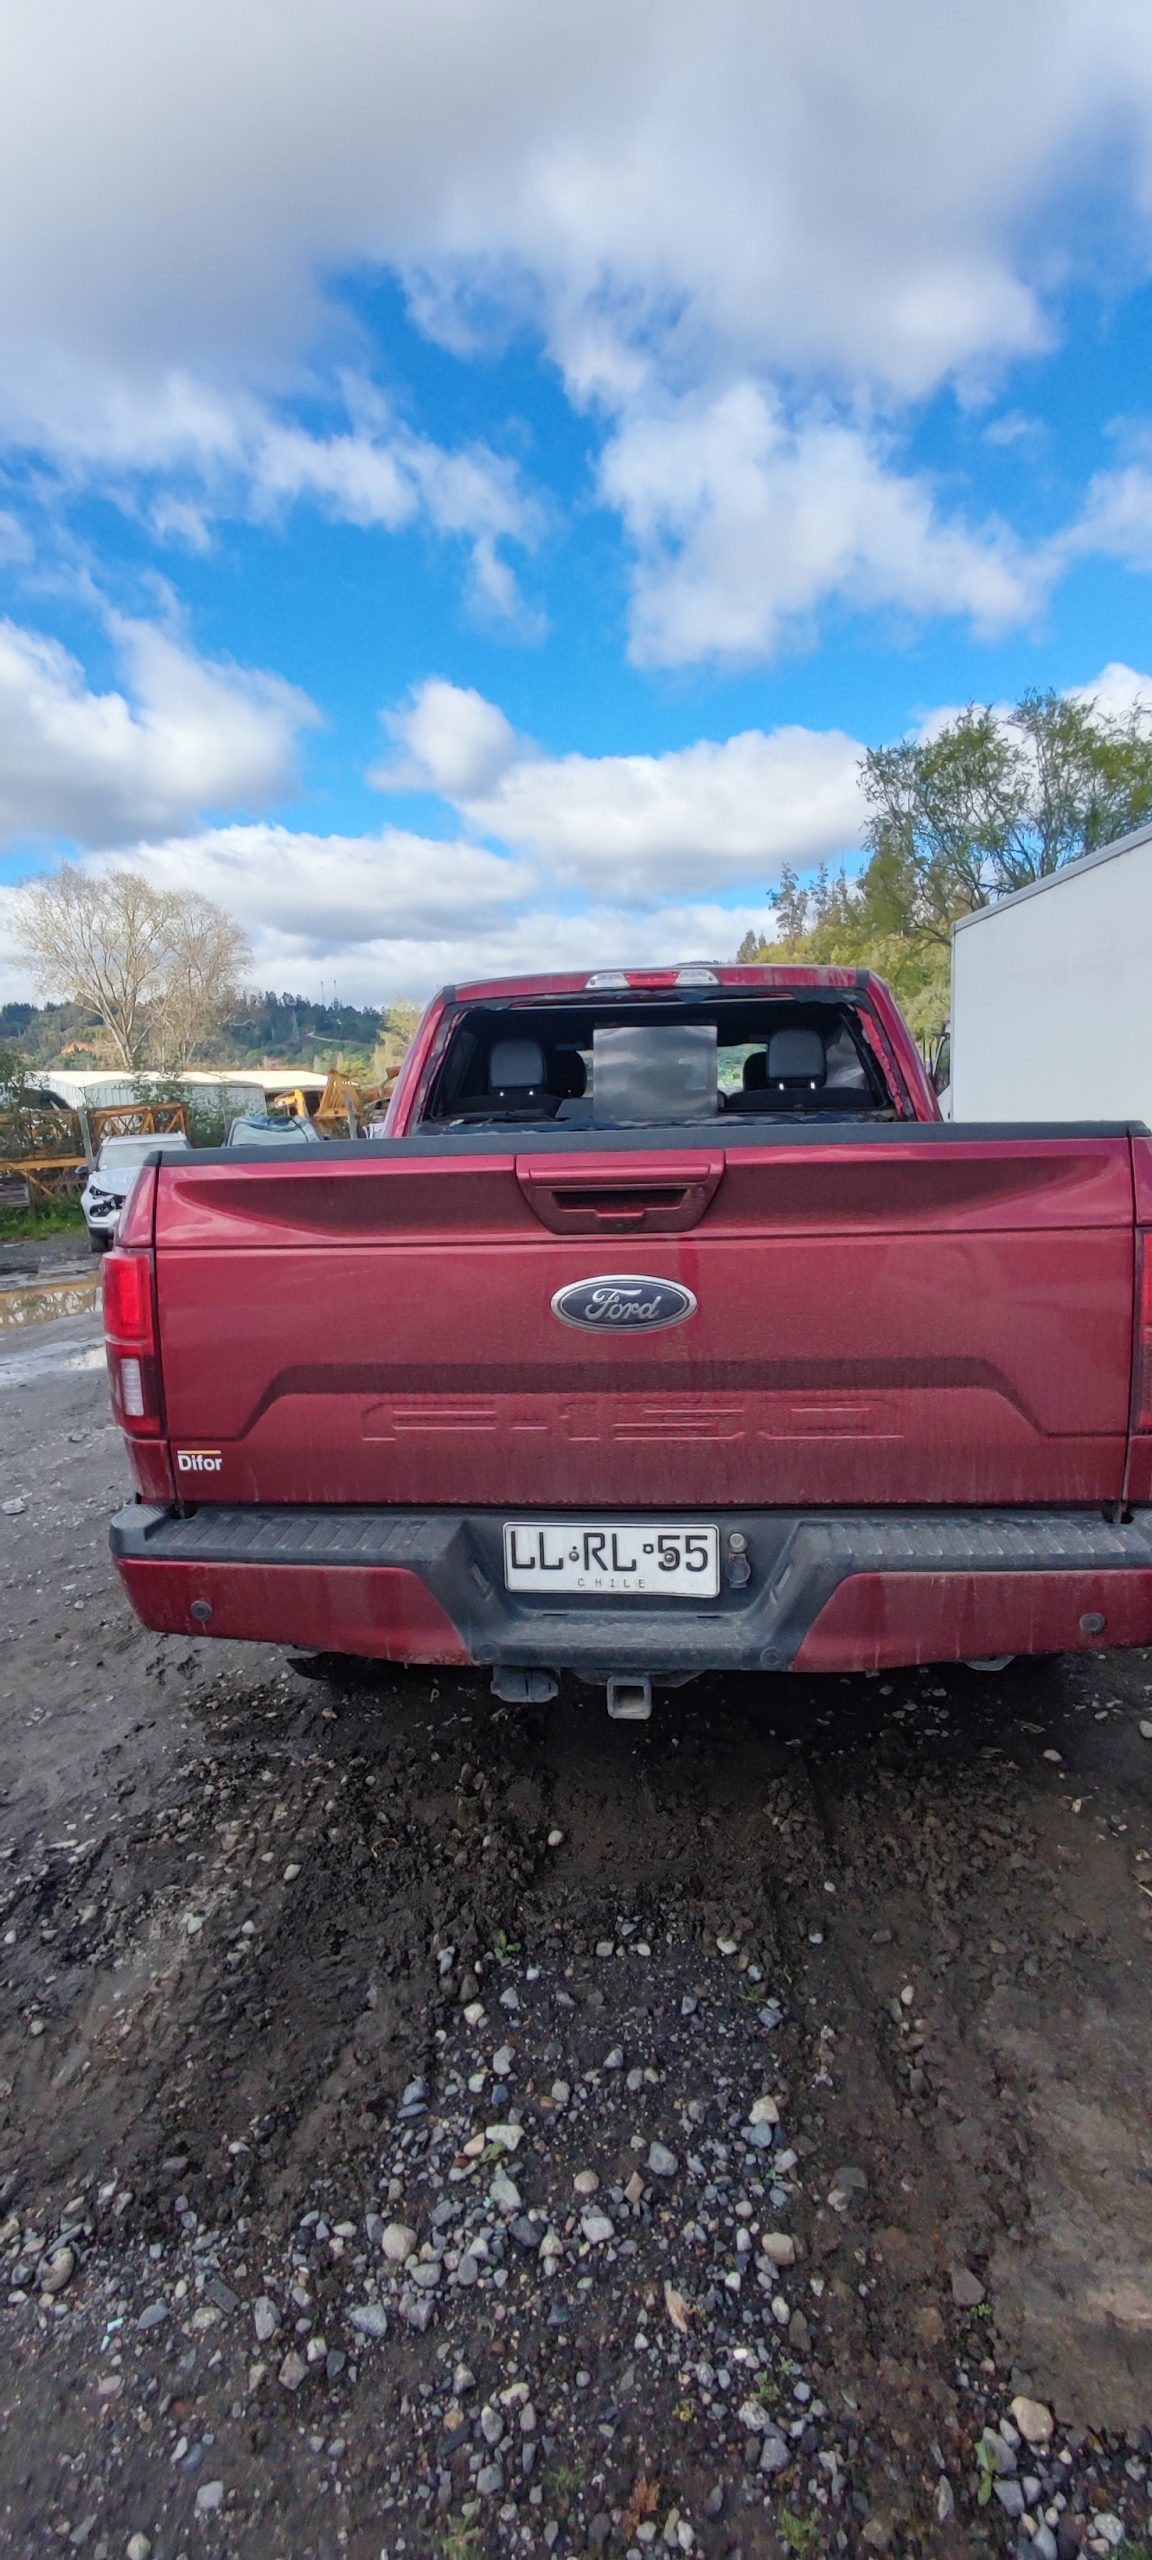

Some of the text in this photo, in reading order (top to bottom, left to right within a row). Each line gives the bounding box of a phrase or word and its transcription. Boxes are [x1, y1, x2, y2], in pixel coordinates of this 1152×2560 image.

[584, 1287, 662, 1319] Ford
[177, 1454, 223, 1471] Difor
[577, 1577, 645, 1589] CHILE
